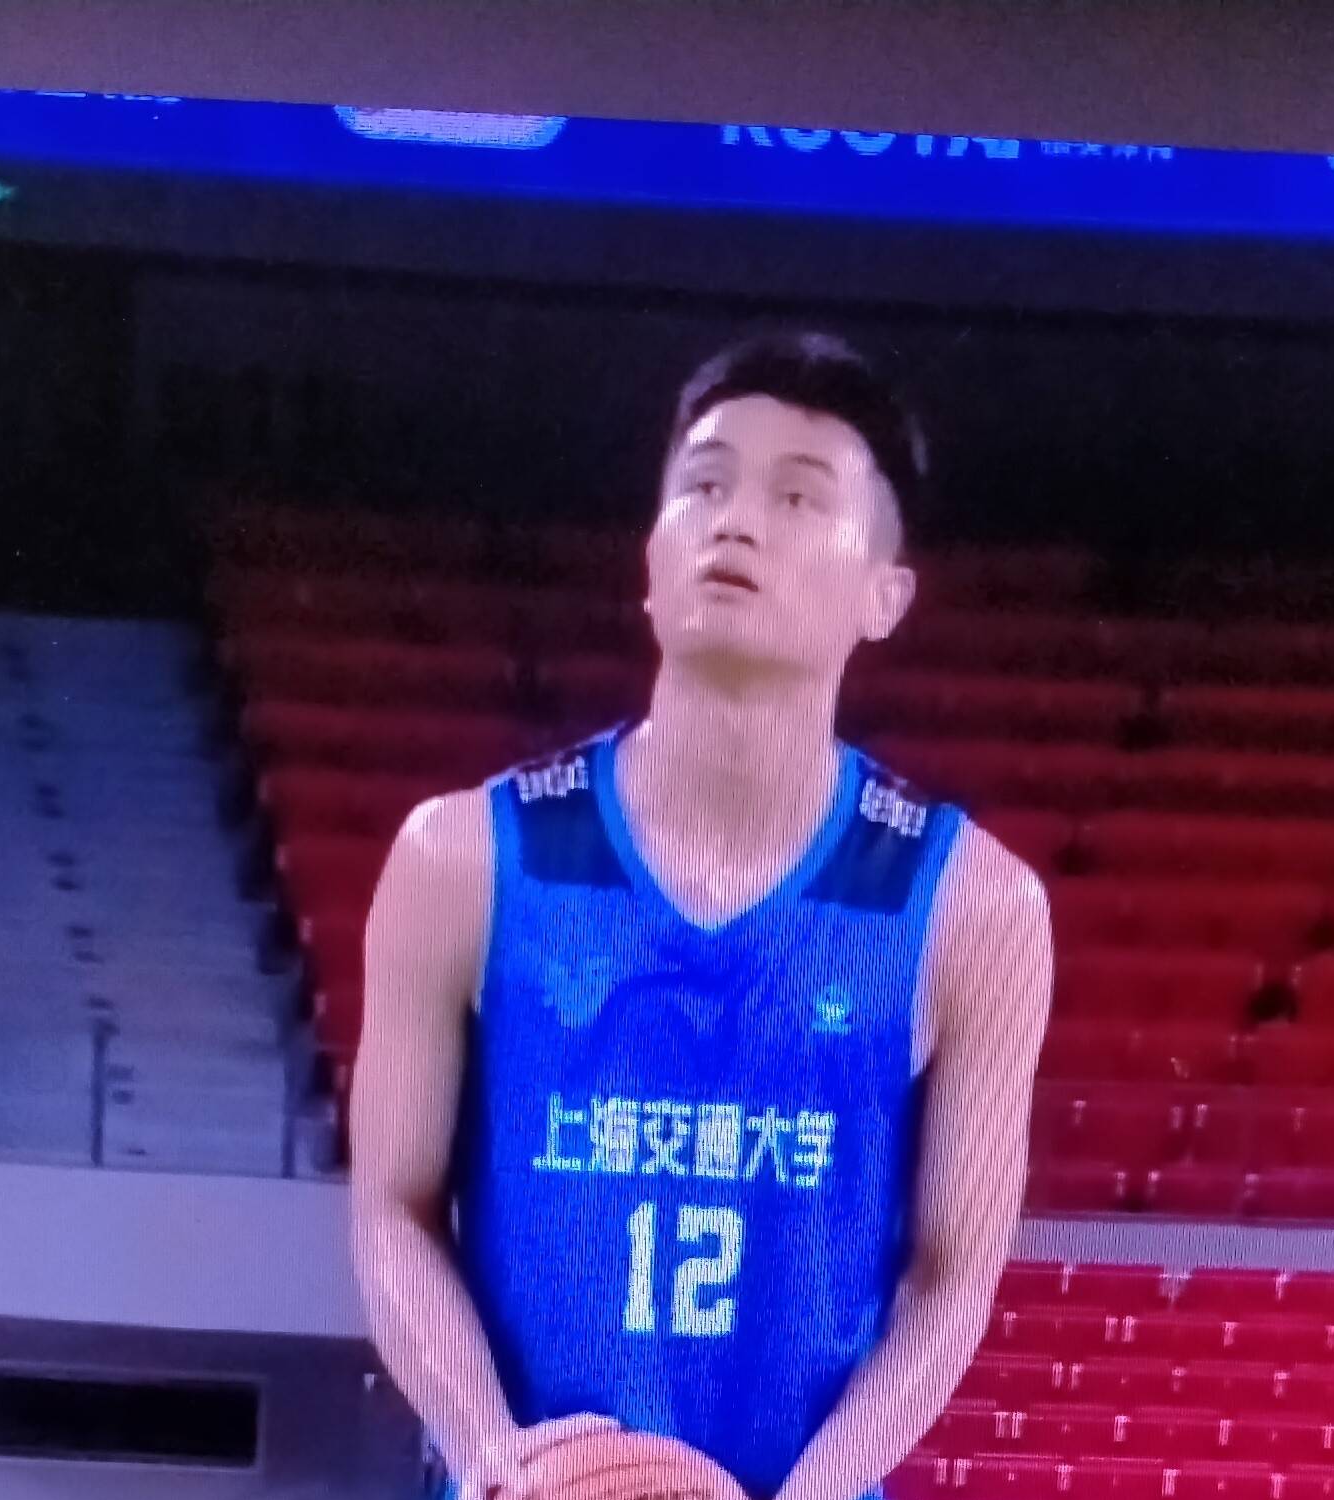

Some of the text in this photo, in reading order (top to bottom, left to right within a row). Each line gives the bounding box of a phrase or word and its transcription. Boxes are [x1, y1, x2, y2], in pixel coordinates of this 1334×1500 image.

[532, 1092, 837, 1190] 上海交通大学
[623, 1201, 744, 1337] 12
